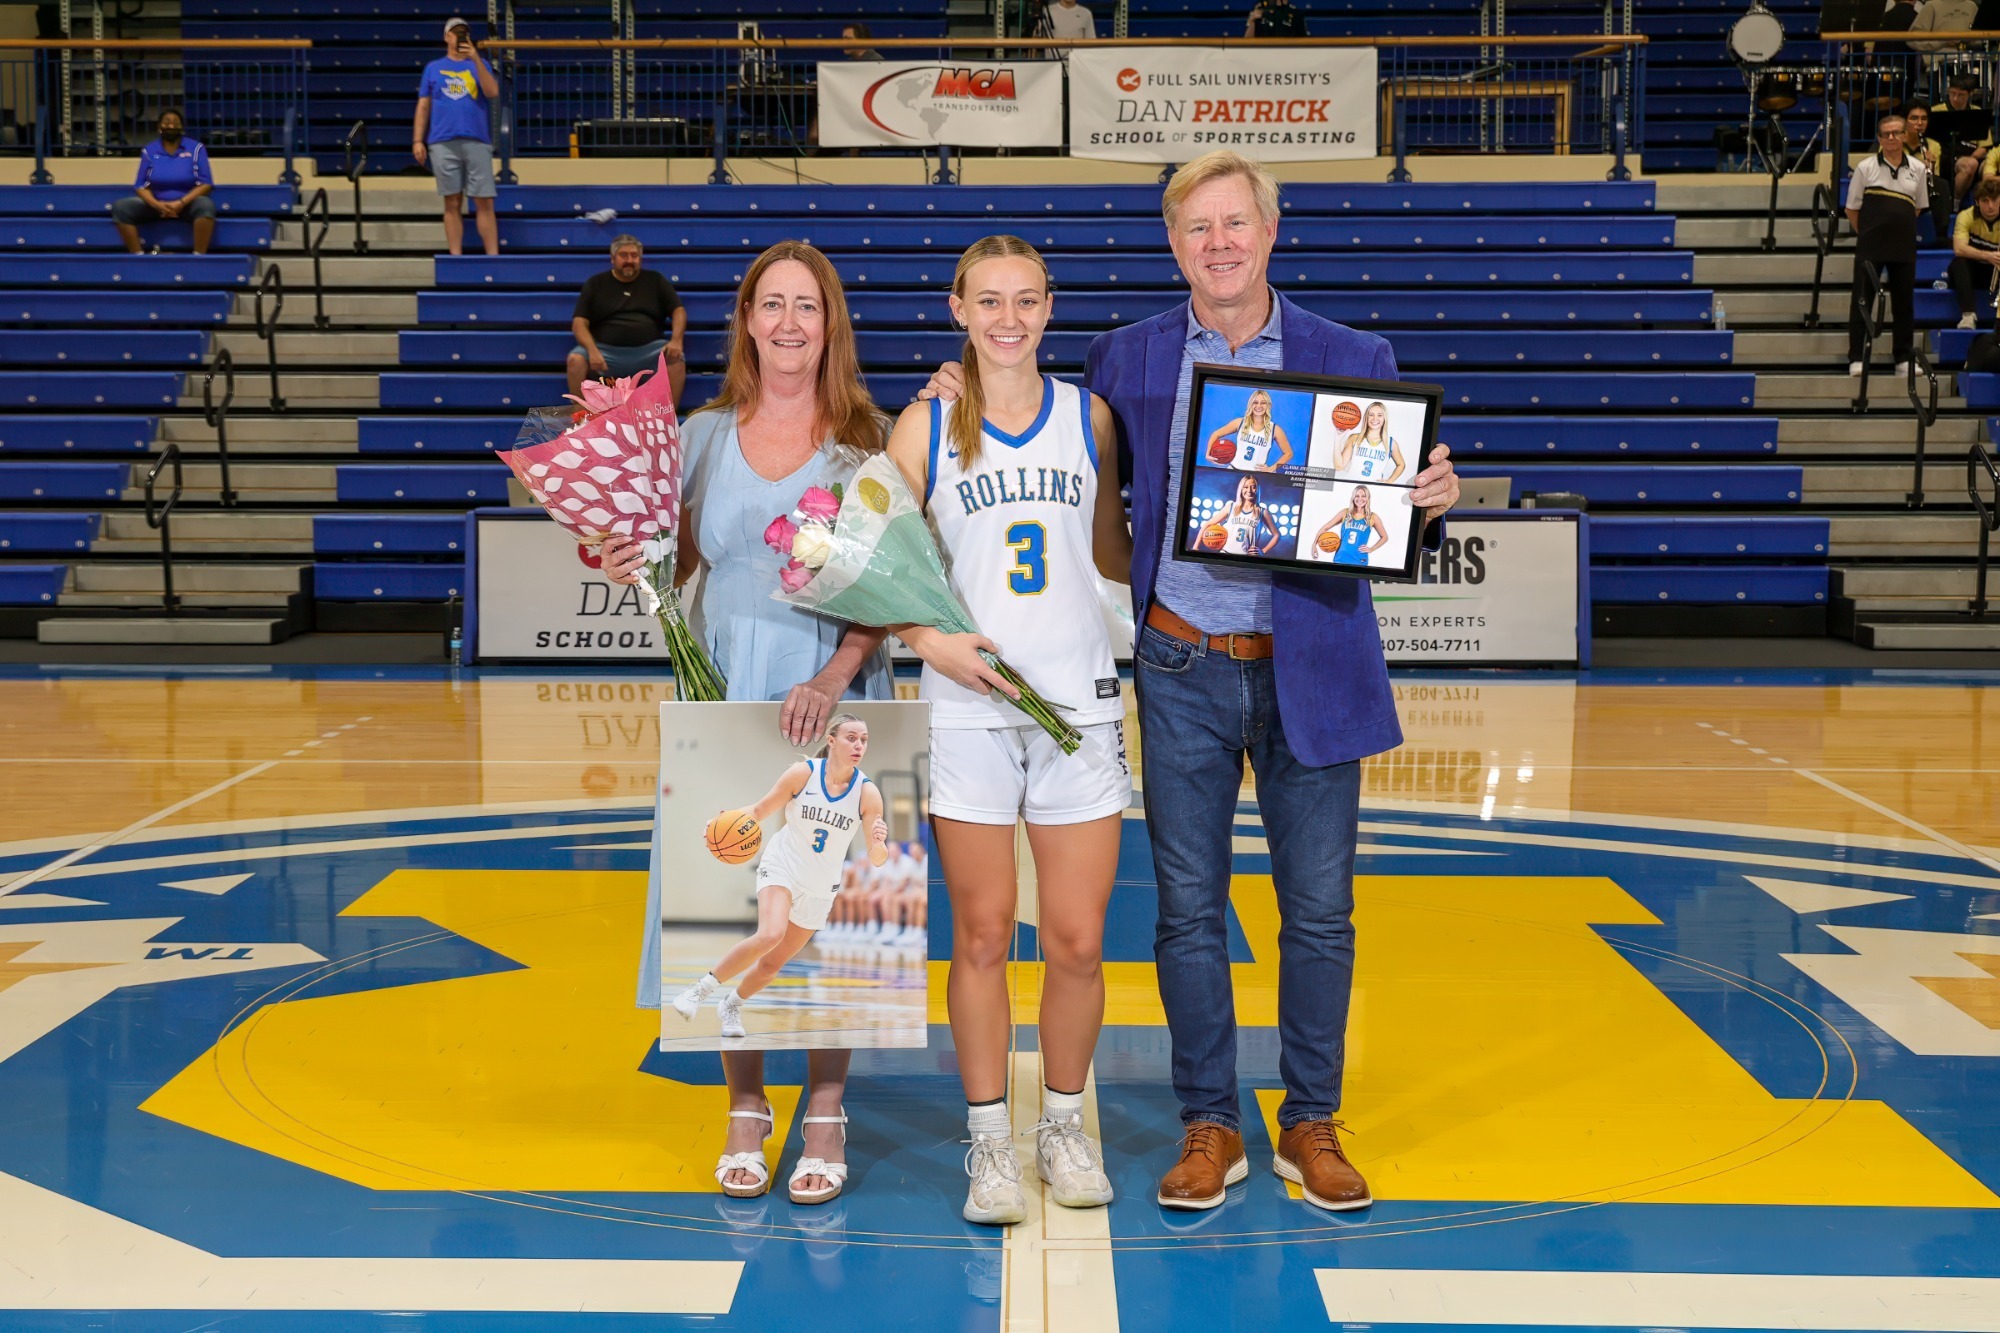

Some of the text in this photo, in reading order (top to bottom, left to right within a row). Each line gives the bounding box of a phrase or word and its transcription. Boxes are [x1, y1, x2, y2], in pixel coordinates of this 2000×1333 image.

[932, 67, 1017, 100] MCA
[1148, 72, 1331, 86] FULL SAIL UNIVERSITY'S
[933, 103, 1019, 113] TRANSPORTATION
[1116, 99, 1331, 123] DAN PATRICK
[1091, 132, 1165, 144] SCHOOL
[1193, 131, 1356, 144] SPORTSCASTING
[1244, 445, 1255, 461] 3
[1362, 460, 1373, 477] 3
[956, 467, 1083, 516] ROLLINS
[1235, 527, 1246, 543] 3
[1347, 530, 1358, 545] 3
[1005, 520, 1049, 596] 3
[1409, 616, 1486, 627] EXPERTS
[536, 631, 653, 648] SCHOOL
[802, 805, 854, 831] ROLLINS
[812, 828, 829, 853] 3
[144, 947, 254, 960] TM
